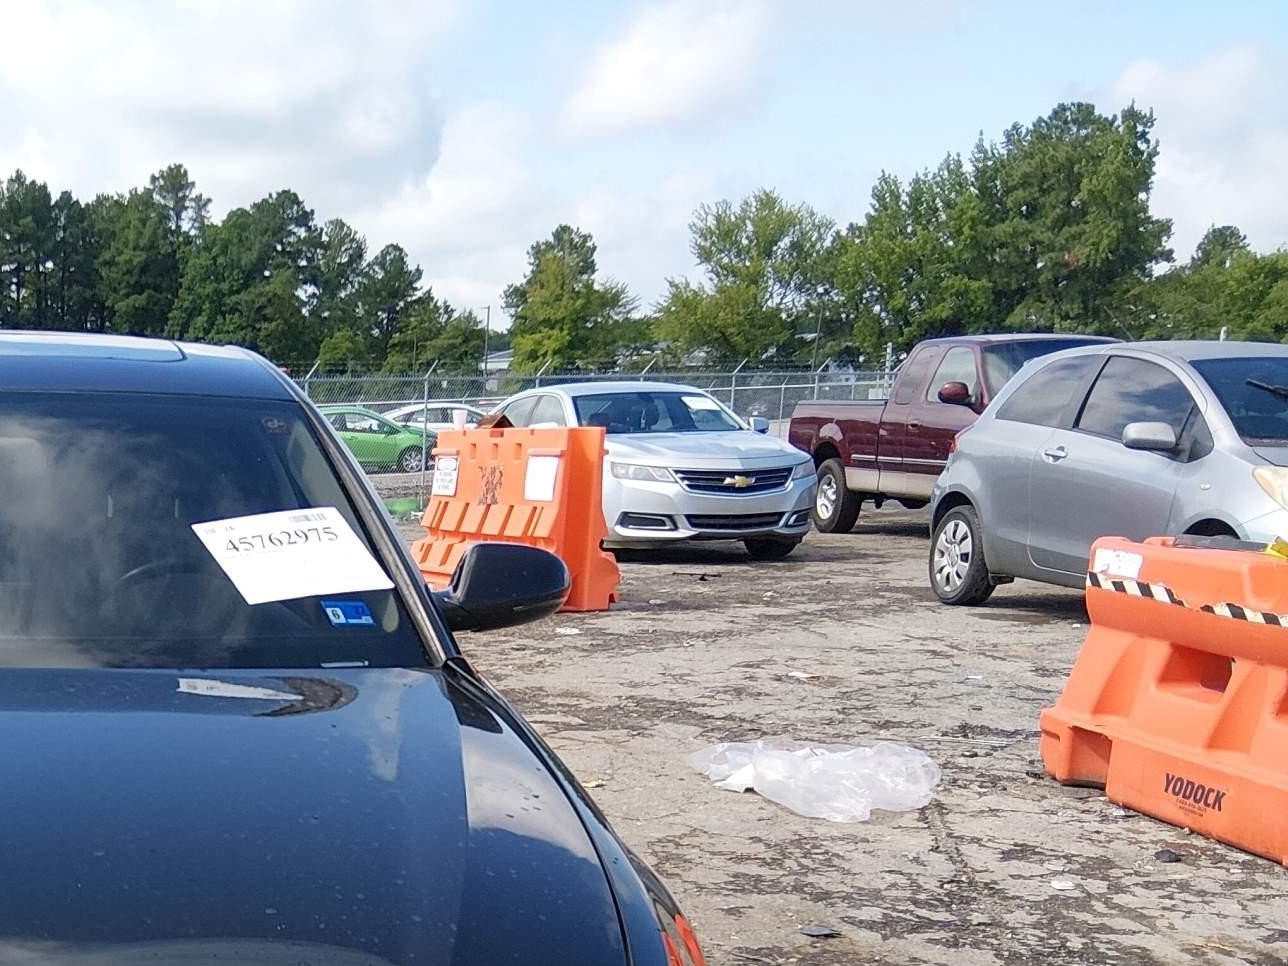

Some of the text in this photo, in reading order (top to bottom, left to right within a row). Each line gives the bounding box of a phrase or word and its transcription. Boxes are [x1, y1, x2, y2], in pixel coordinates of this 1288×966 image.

[226, 526, 339, 552] 45762975
[330, 609, 341, 620] 6
[1163, 773, 1227, 812] YODOCK
